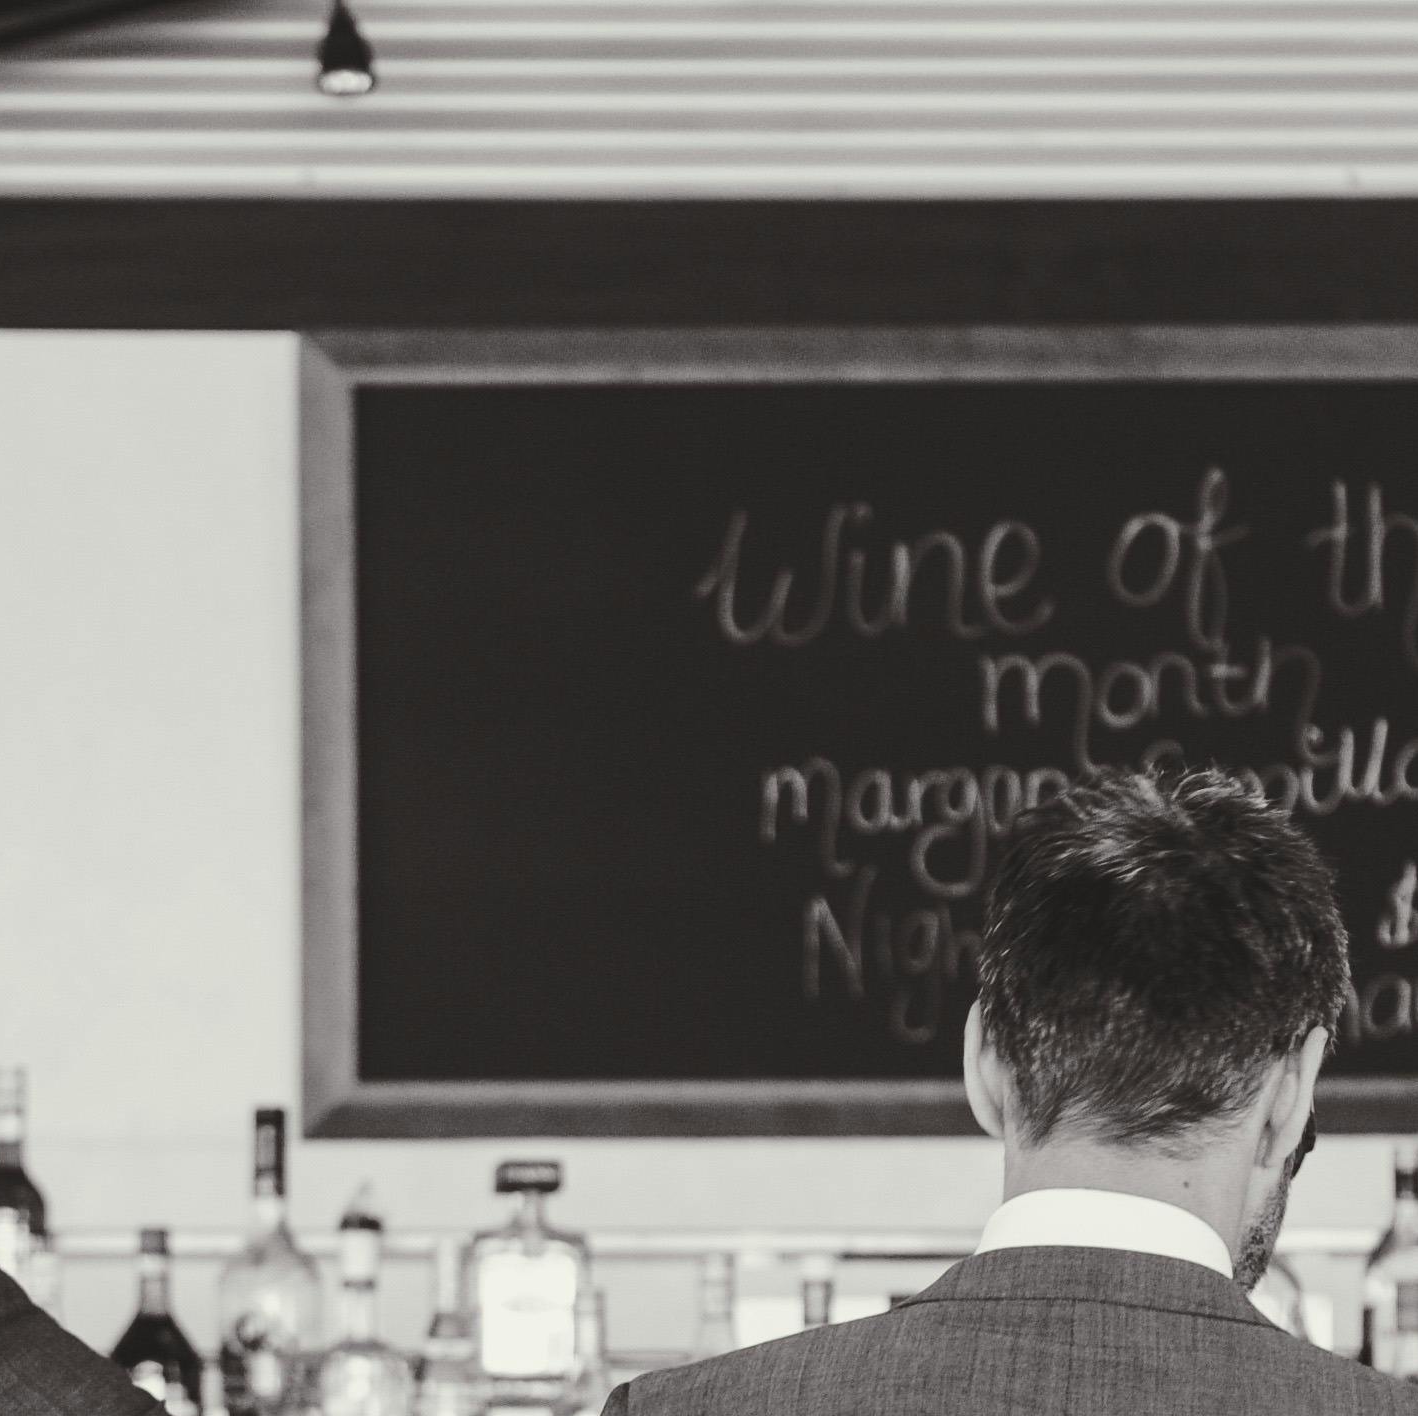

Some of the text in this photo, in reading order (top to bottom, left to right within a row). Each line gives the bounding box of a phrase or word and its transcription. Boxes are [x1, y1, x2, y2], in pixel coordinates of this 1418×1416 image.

[696, 500, 1055, 646] Wine
[1106, 465, 1248, 653] of
[981, 637, 1333, 768] month
[802, 864, 983, 1044] Nigh
